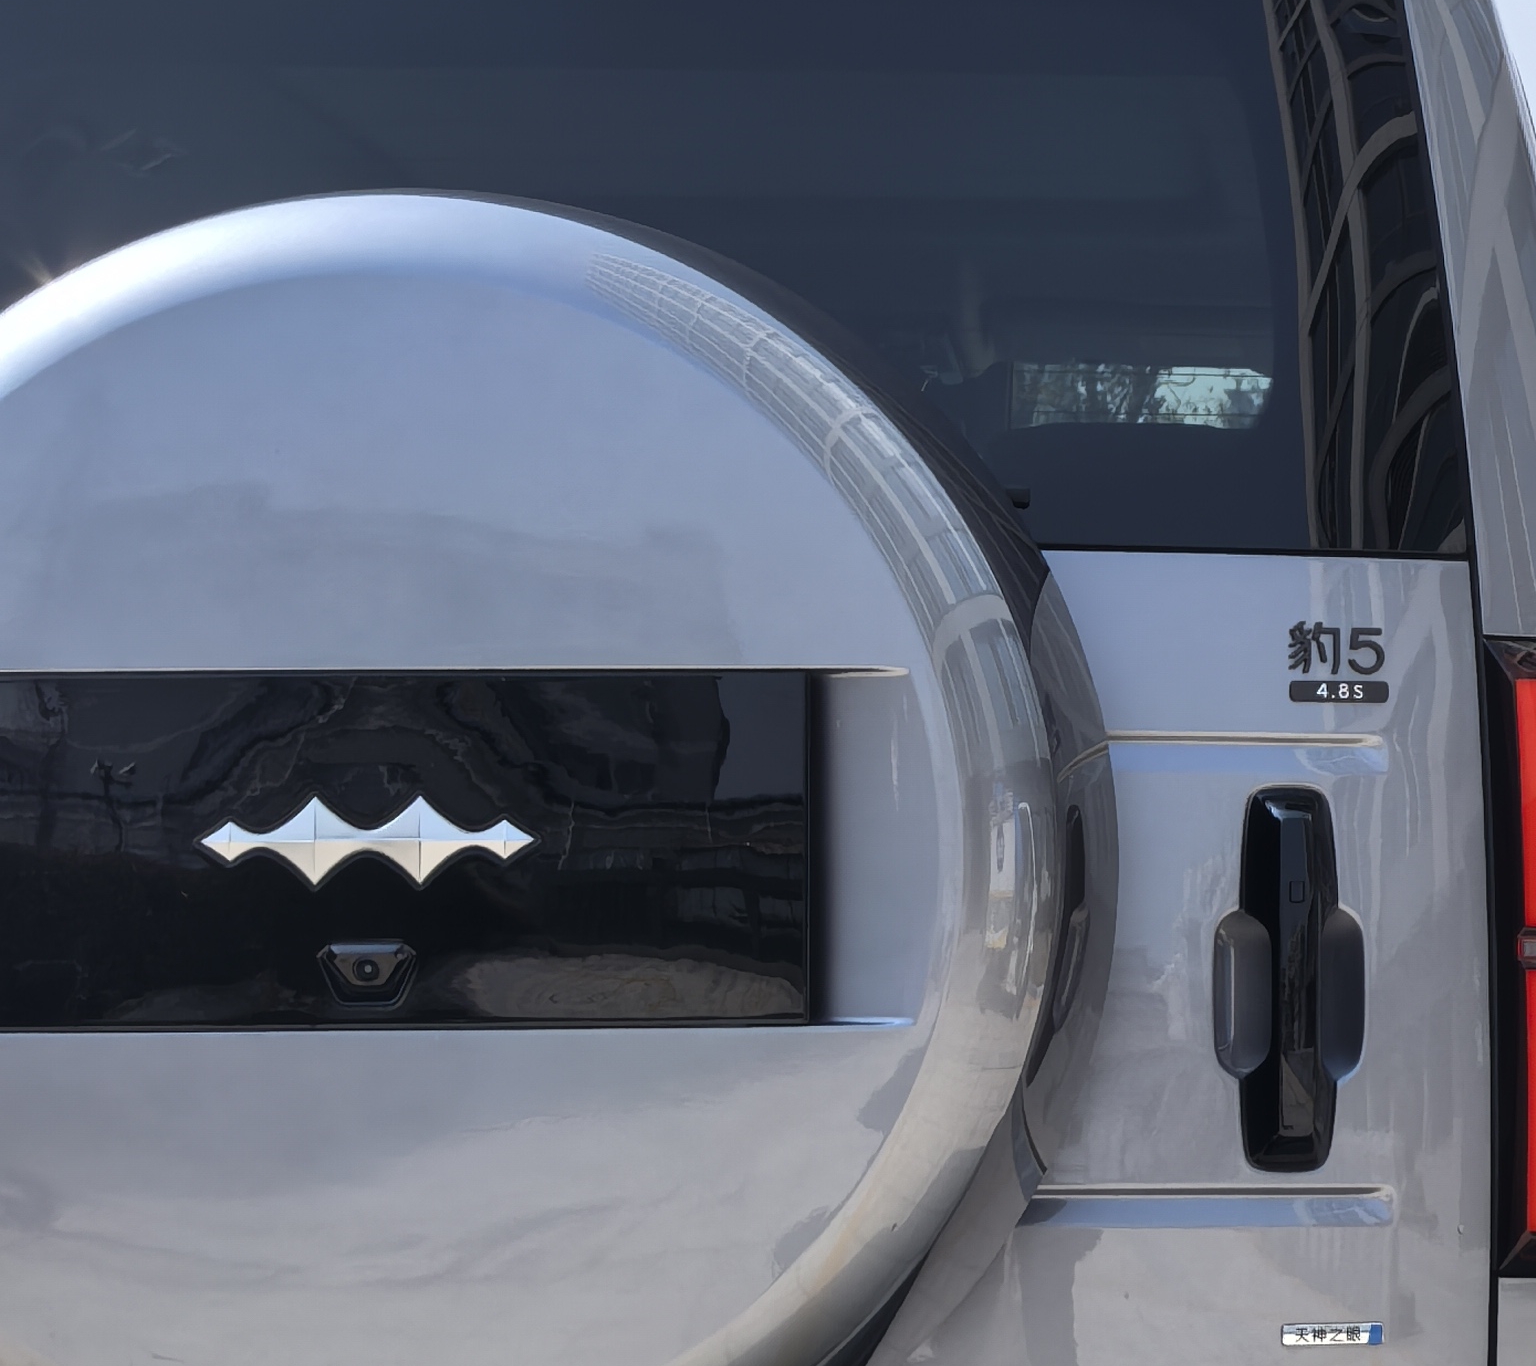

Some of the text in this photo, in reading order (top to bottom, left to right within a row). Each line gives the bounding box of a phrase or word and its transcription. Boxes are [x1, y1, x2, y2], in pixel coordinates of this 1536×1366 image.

[1288, 620, 1385, 675] 豹5
[1316, 683, 1364, 699] 4.8S
[1294, 1325, 1362, 1343] 天神之眼
